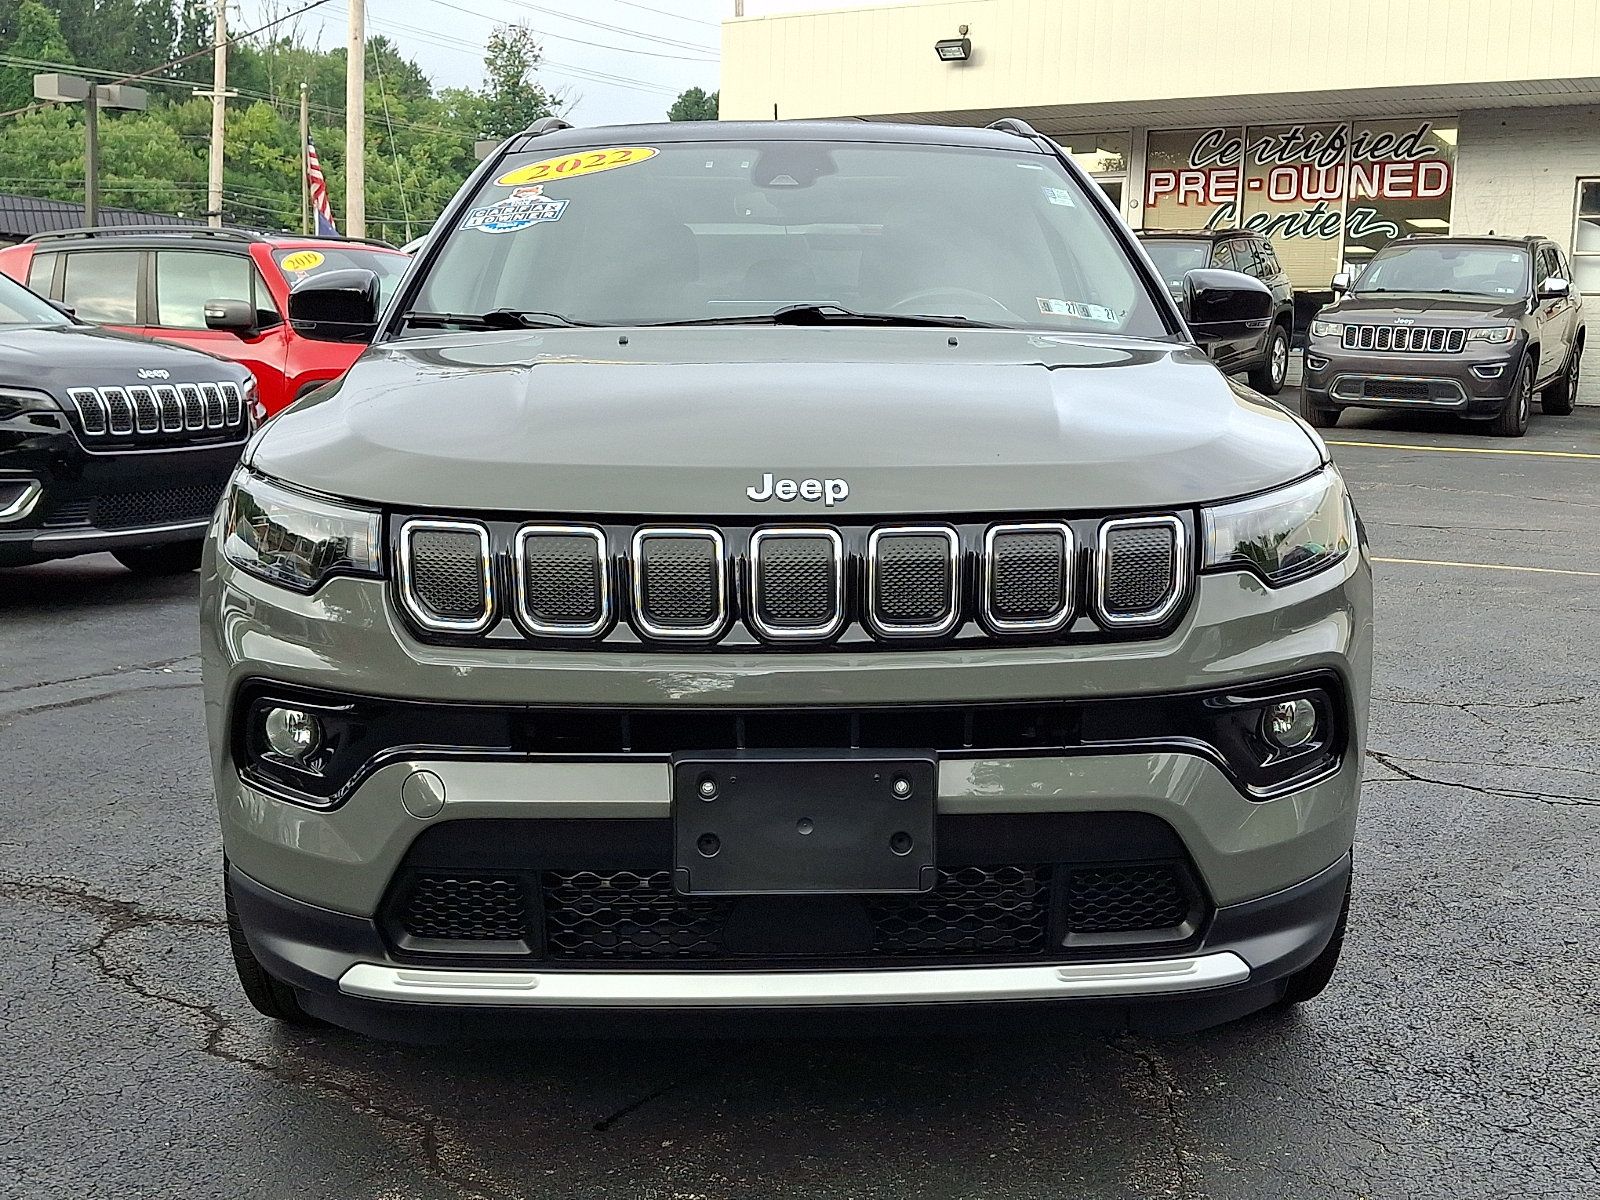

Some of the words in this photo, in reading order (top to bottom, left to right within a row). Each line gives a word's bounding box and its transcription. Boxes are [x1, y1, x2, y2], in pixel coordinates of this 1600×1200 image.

[1189, 121, 1439, 169] Certified
[527, 150, 633, 180] 2022
[1147, 160, 1450, 207] PRE-OWNED
[474, 203, 559, 217] CARFAX
[484, 210, 557, 224] OWNER
[1204, 200, 1399, 240] Center
[288, 253, 318, 270] 2019
[1394, 317, 1415, 325] Jeep
[137, 368, 170, 380] Jeep
[746, 473, 849, 507] Jeep
